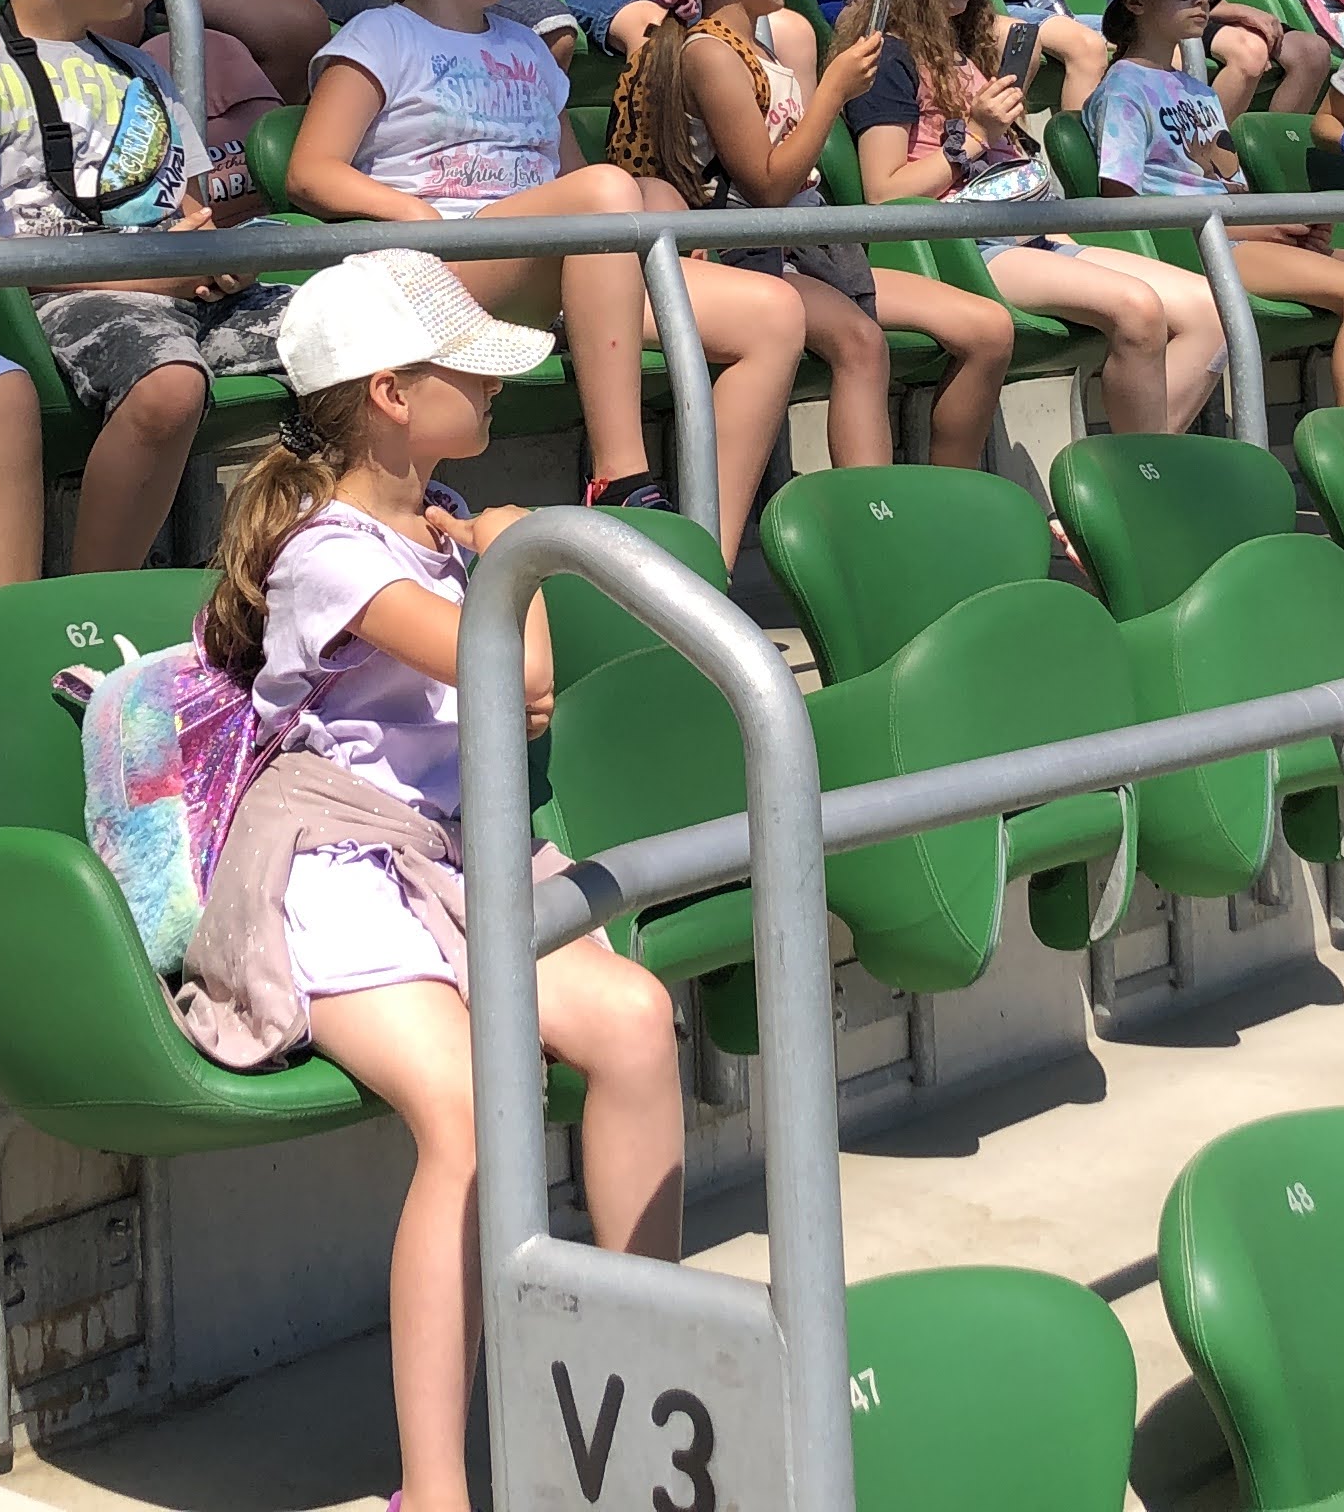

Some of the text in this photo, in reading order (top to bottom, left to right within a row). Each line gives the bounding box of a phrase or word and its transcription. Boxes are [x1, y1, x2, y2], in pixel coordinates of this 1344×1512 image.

[118, 104, 161, 175] CHILL
[431, 154, 545, 189] Sunshine Lover
[1139, 463, 1160, 480] 65
[869, 500, 893, 520] 64
[66, 622, 104, 648] 62
[1286, 1182, 1314, 1214] 48
[850, 1368, 880, 1411] 47
[550, 1359, 716, 1512] V3
